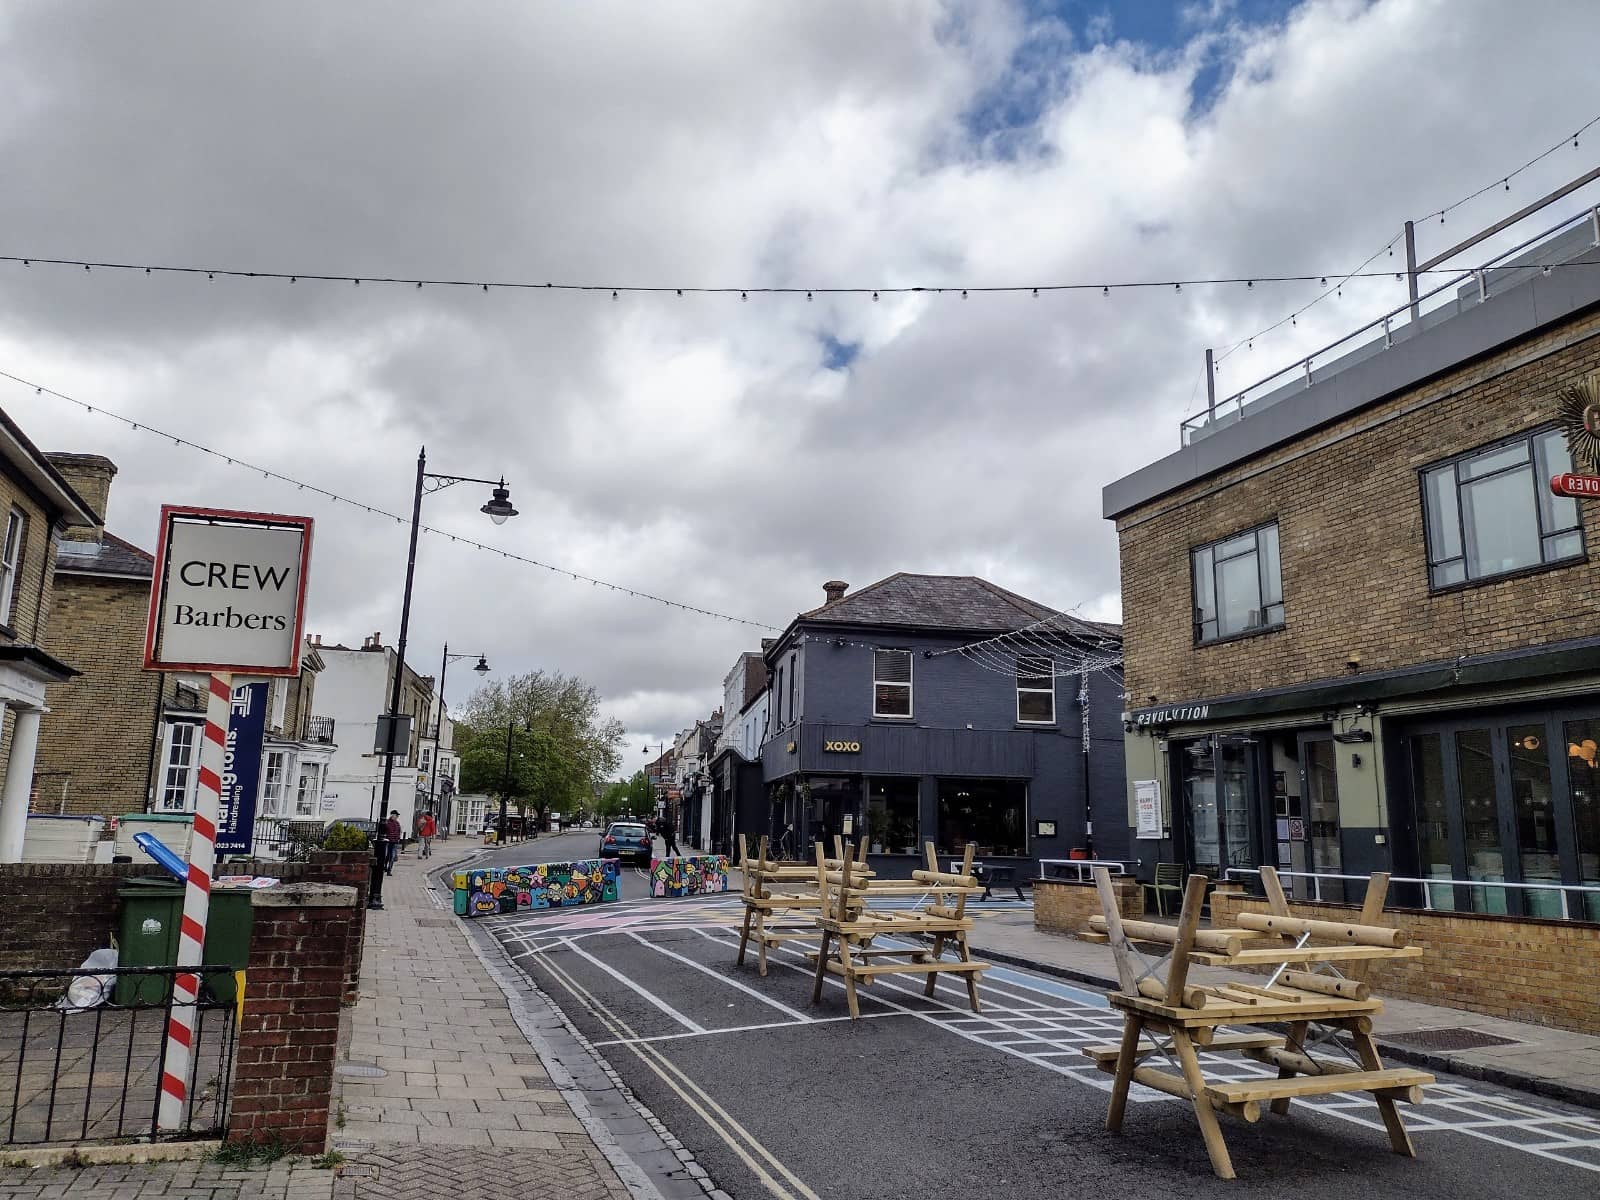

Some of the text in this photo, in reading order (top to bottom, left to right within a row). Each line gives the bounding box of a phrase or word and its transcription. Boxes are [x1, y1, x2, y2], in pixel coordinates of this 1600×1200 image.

[180, 560, 291, 592] CREW
[172, 604, 286, 631] Barbers
[825, 741, 860, 752] XOXO
[228, 785, 243, 834] Hairdressing
